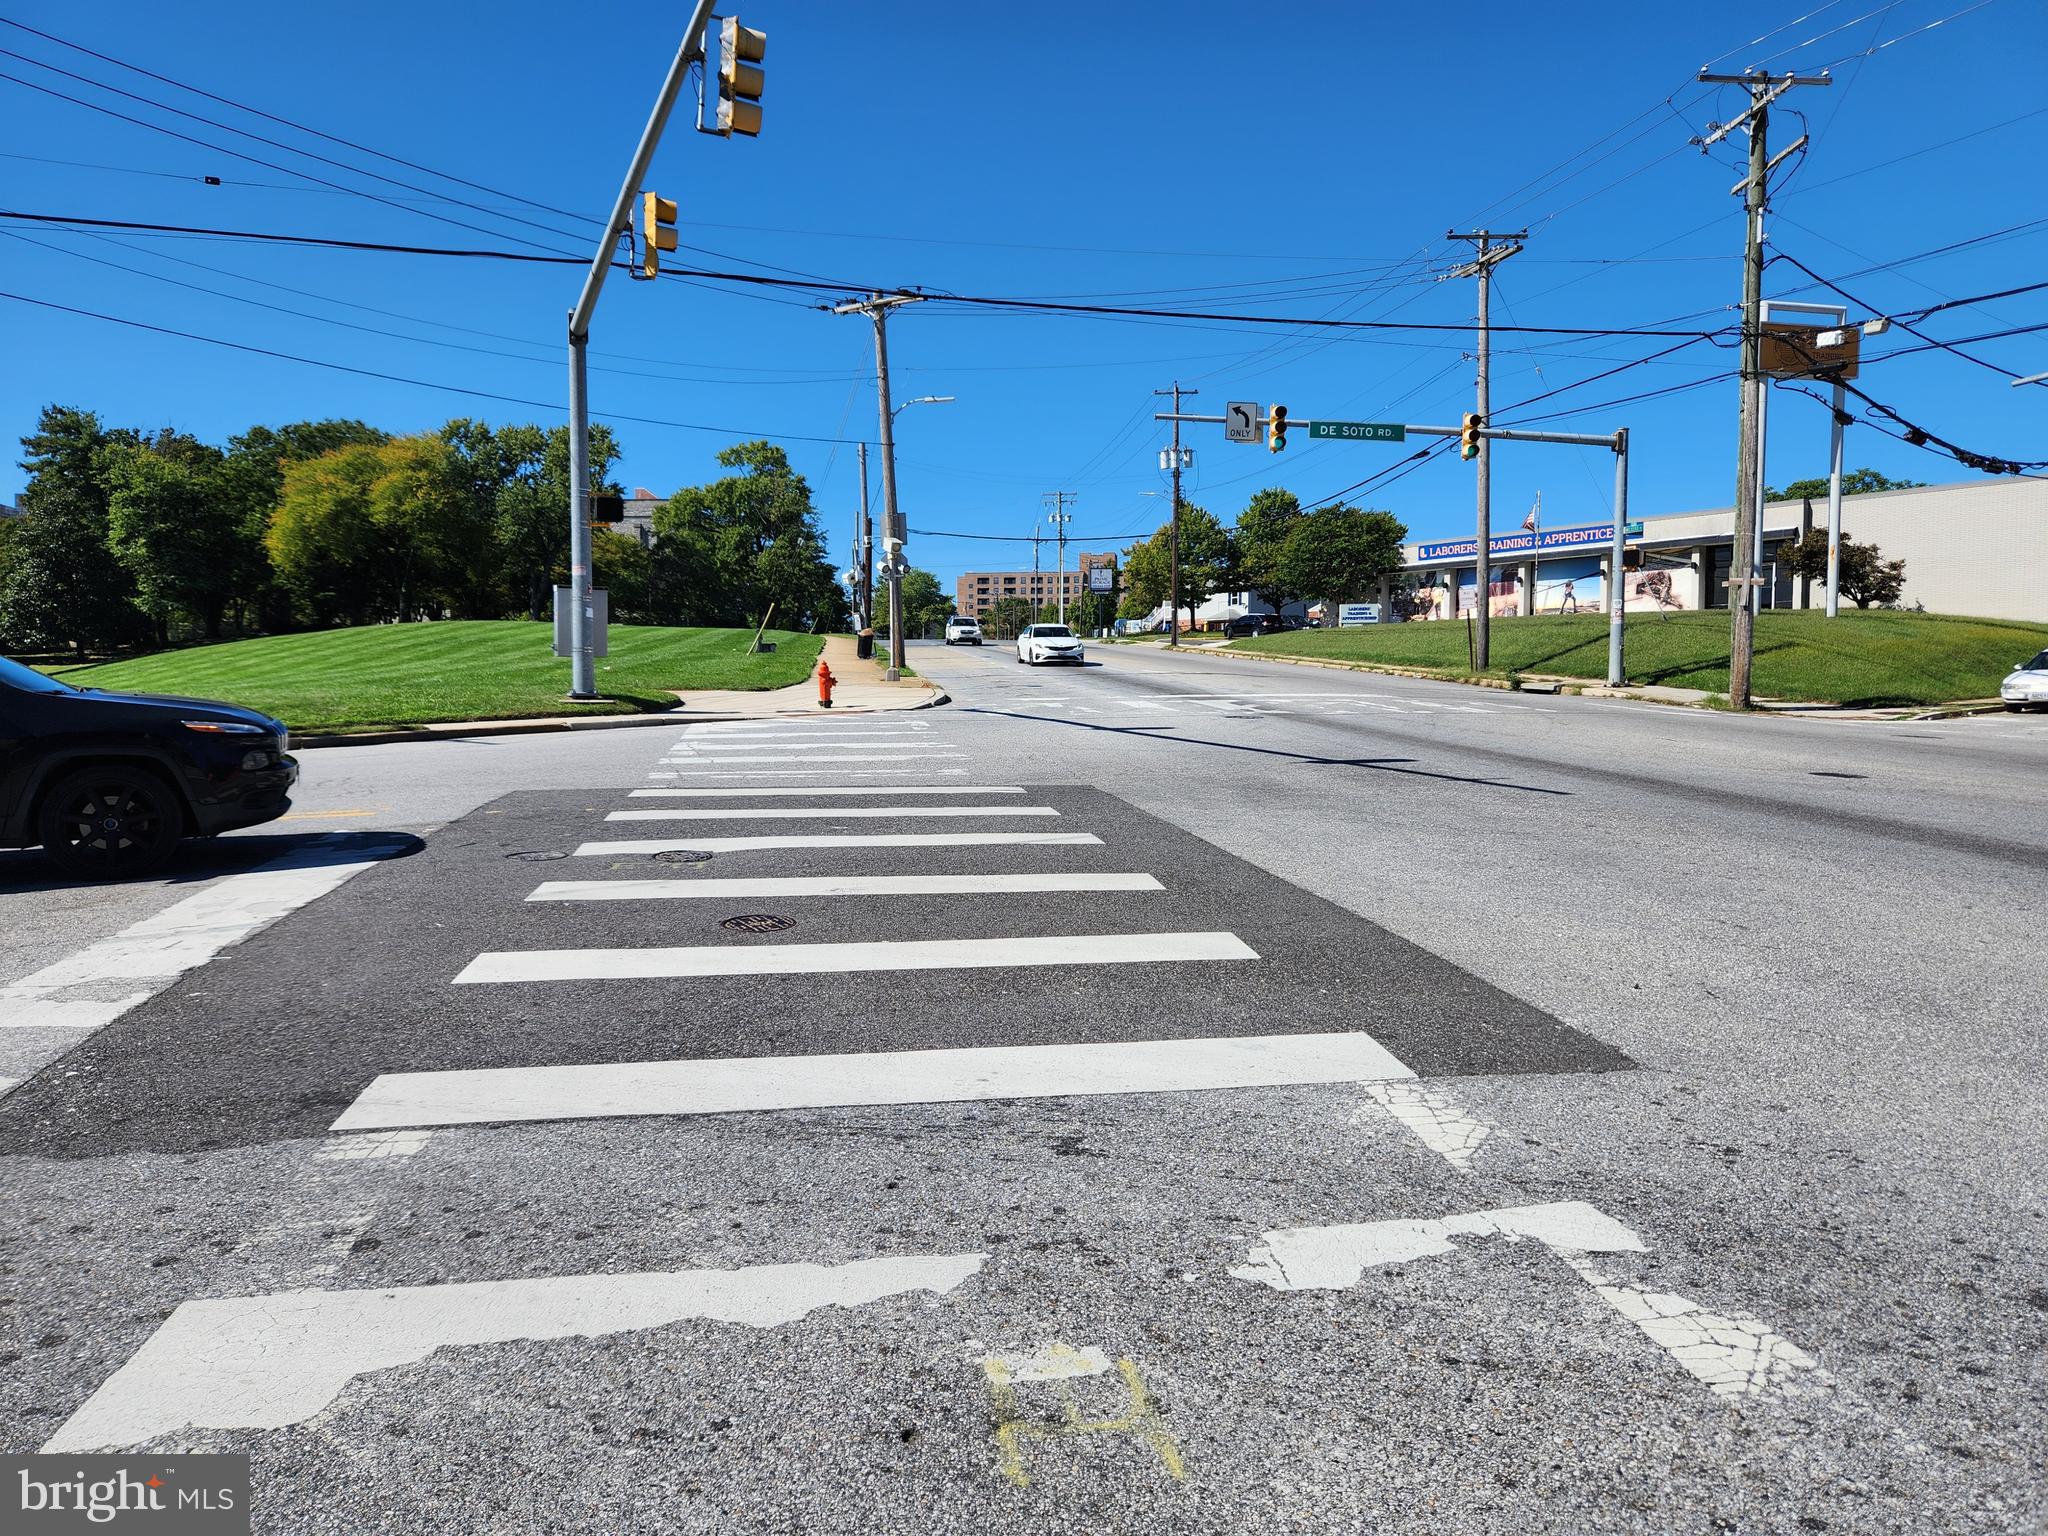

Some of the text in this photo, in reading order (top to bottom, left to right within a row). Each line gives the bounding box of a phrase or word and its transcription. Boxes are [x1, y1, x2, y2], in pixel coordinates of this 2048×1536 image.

[1320, 425, 1395, 437] DE SOTO RD.
[1429, 543, 1478, 557] LABORERS
[1489, 537, 1533, 551] RAINING
